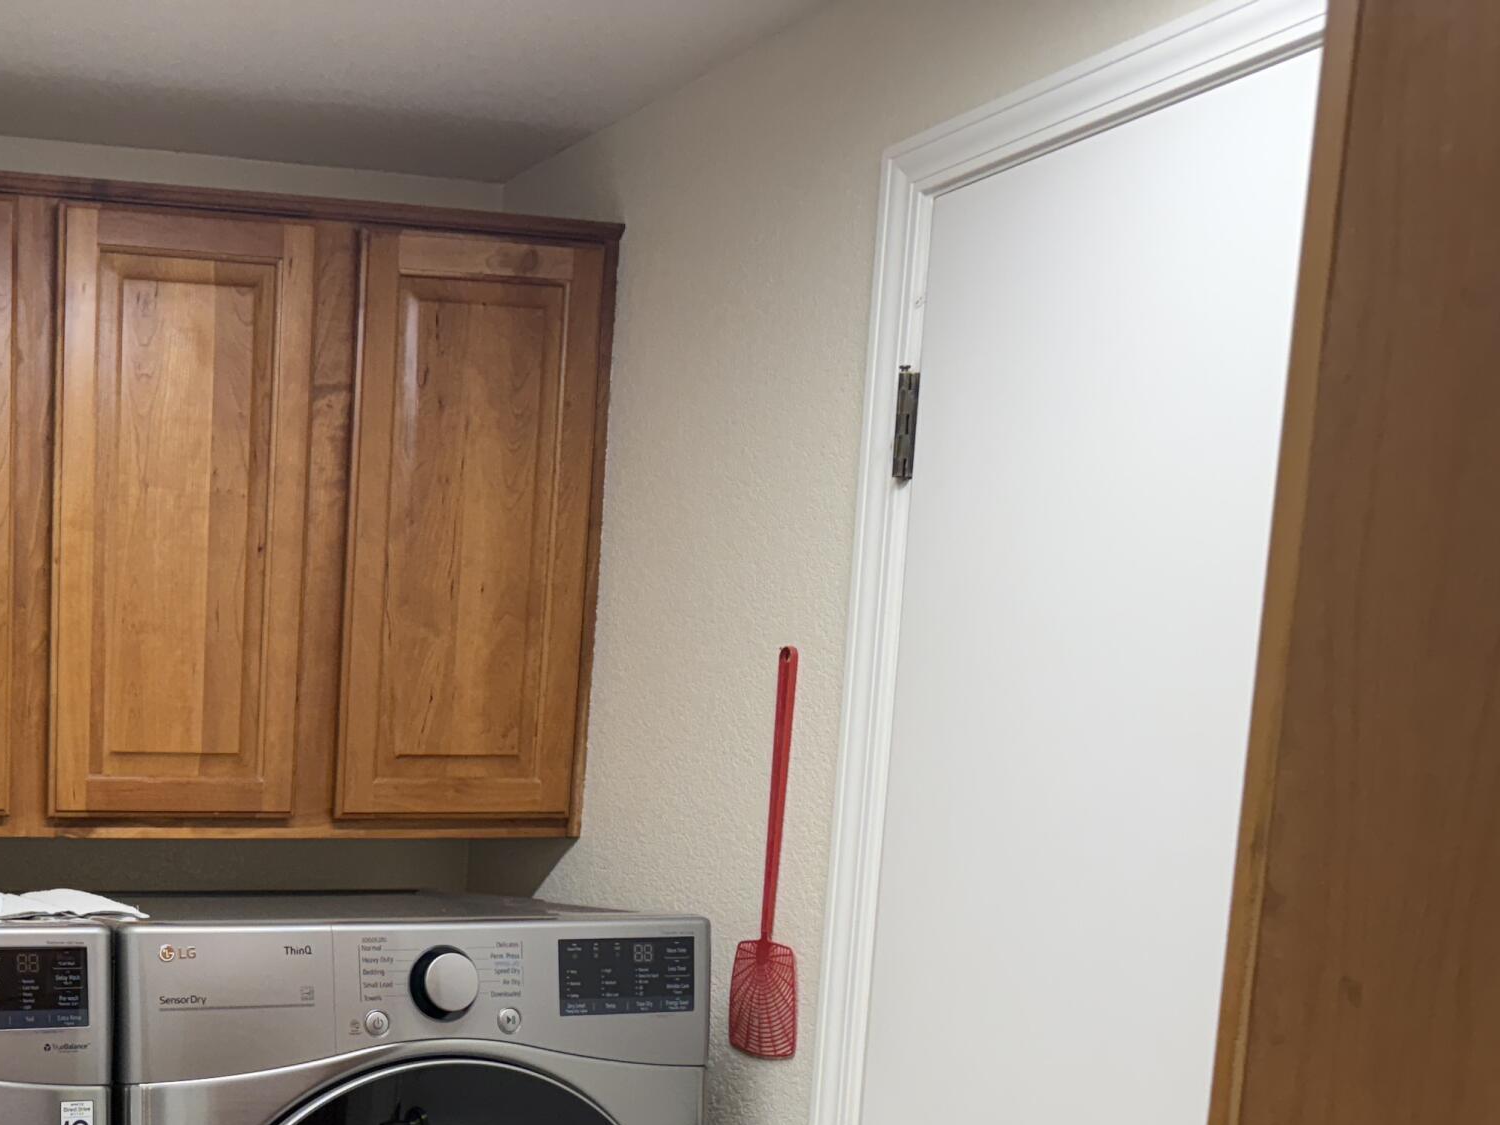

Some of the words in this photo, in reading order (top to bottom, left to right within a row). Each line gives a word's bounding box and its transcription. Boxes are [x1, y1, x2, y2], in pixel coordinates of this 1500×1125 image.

[178, 947, 197, 960] LG
[284, 945, 312, 956] ThinQ
[362, 969, 385, 977] Bedding
[159, 995, 207, 1005] SensorDry
